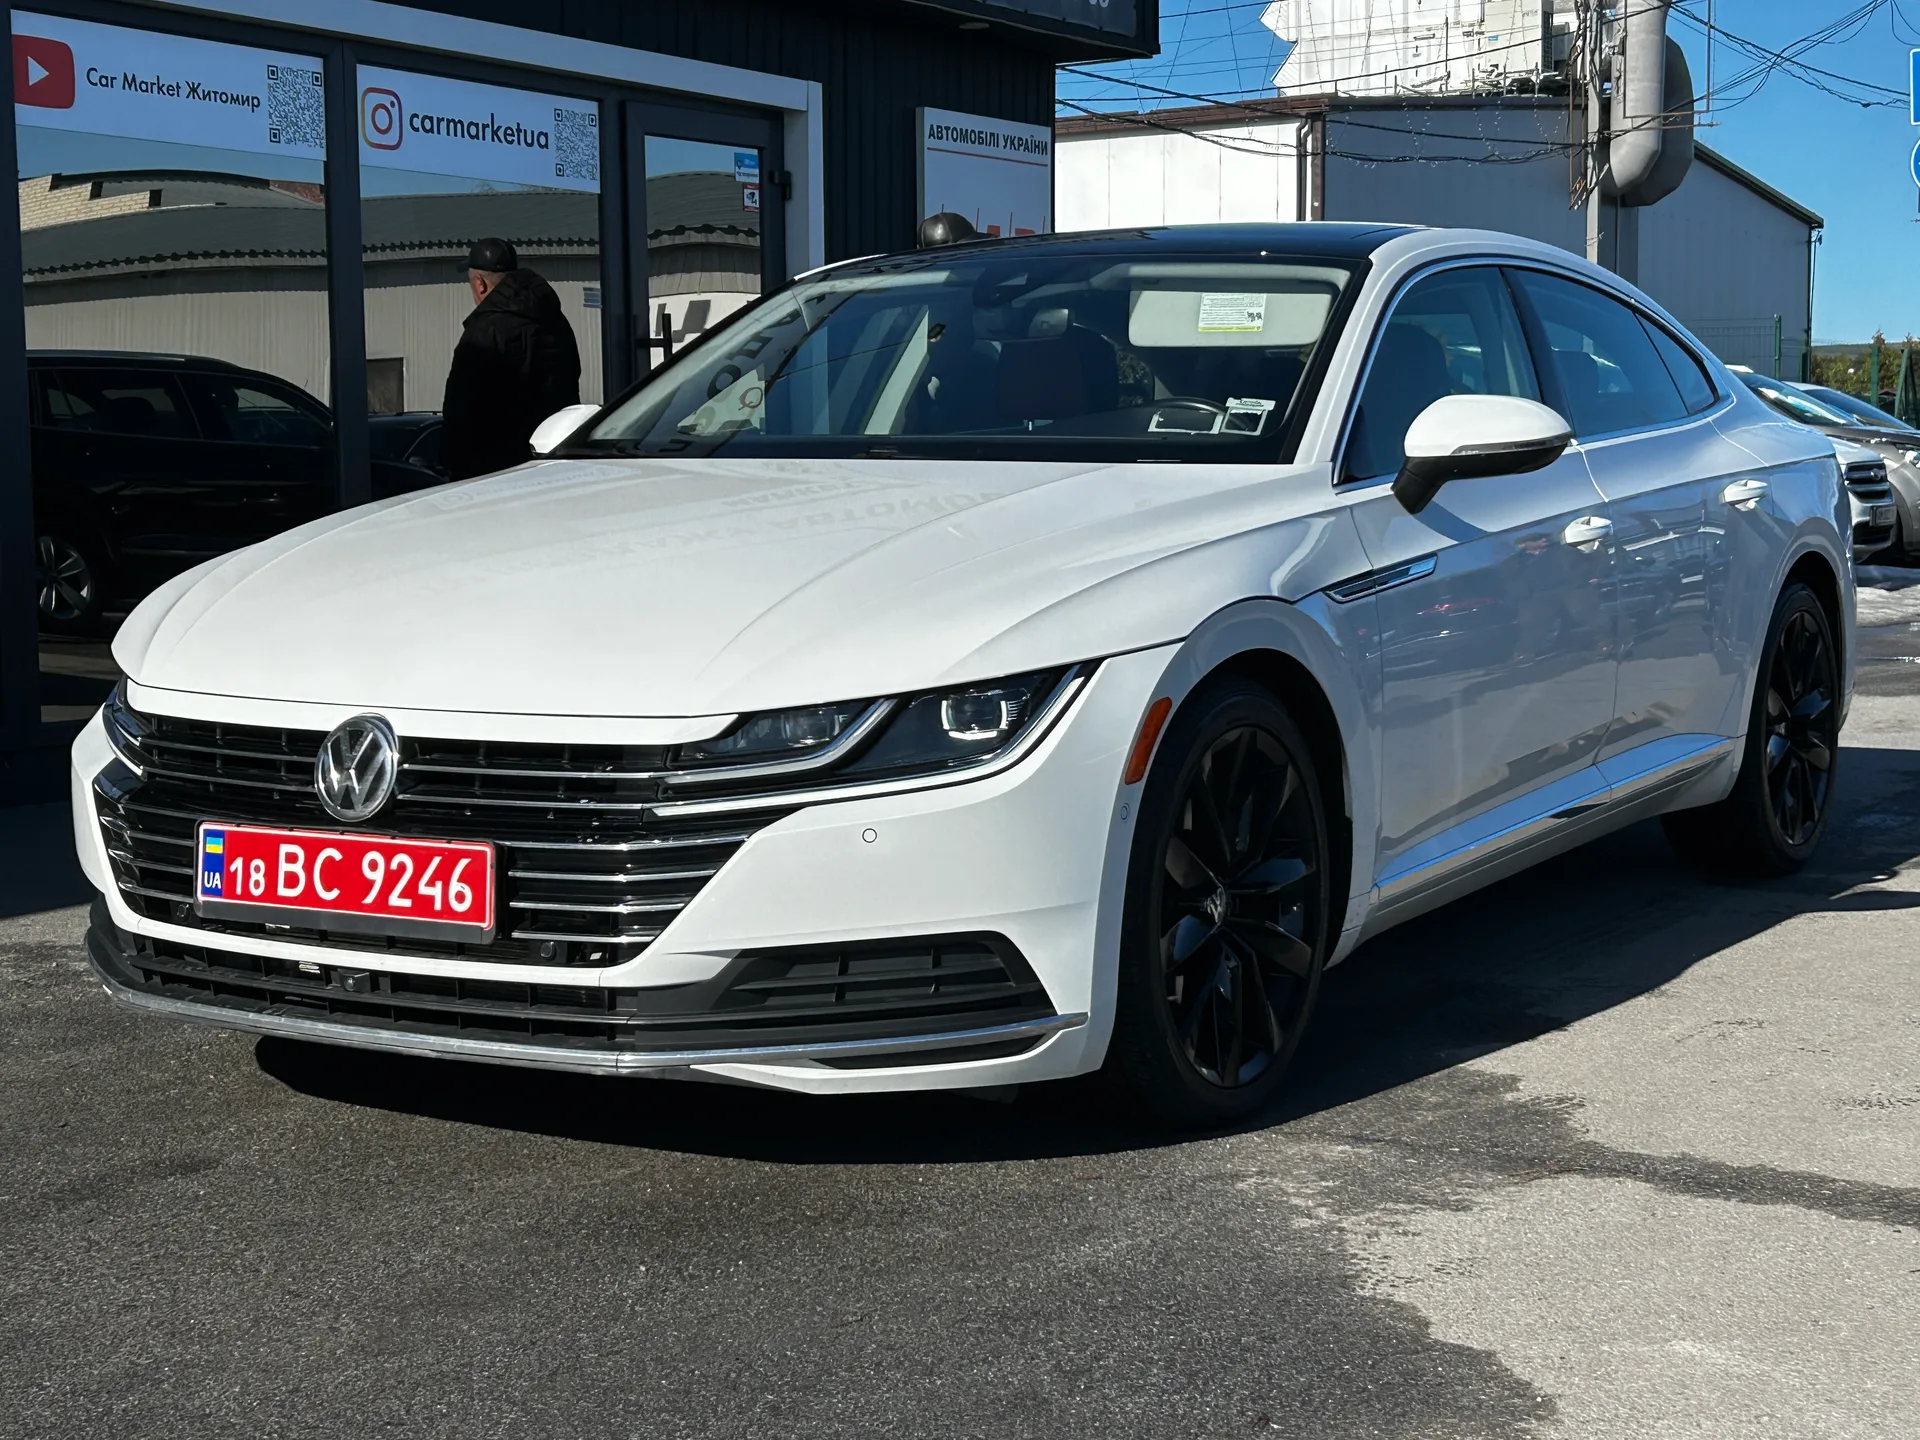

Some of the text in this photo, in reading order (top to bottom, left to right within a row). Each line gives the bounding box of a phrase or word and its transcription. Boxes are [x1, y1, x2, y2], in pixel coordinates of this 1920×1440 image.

[86, 67, 261, 113] Car Market Житомир
[409, 112, 549, 150] carmarketua
[929, 124, 1048, 156] АВТОМОБІЛІ УКРАЇНИ
[204, 872, 222, 889] UA
[229, 843, 473, 913] 18 BC 9246
